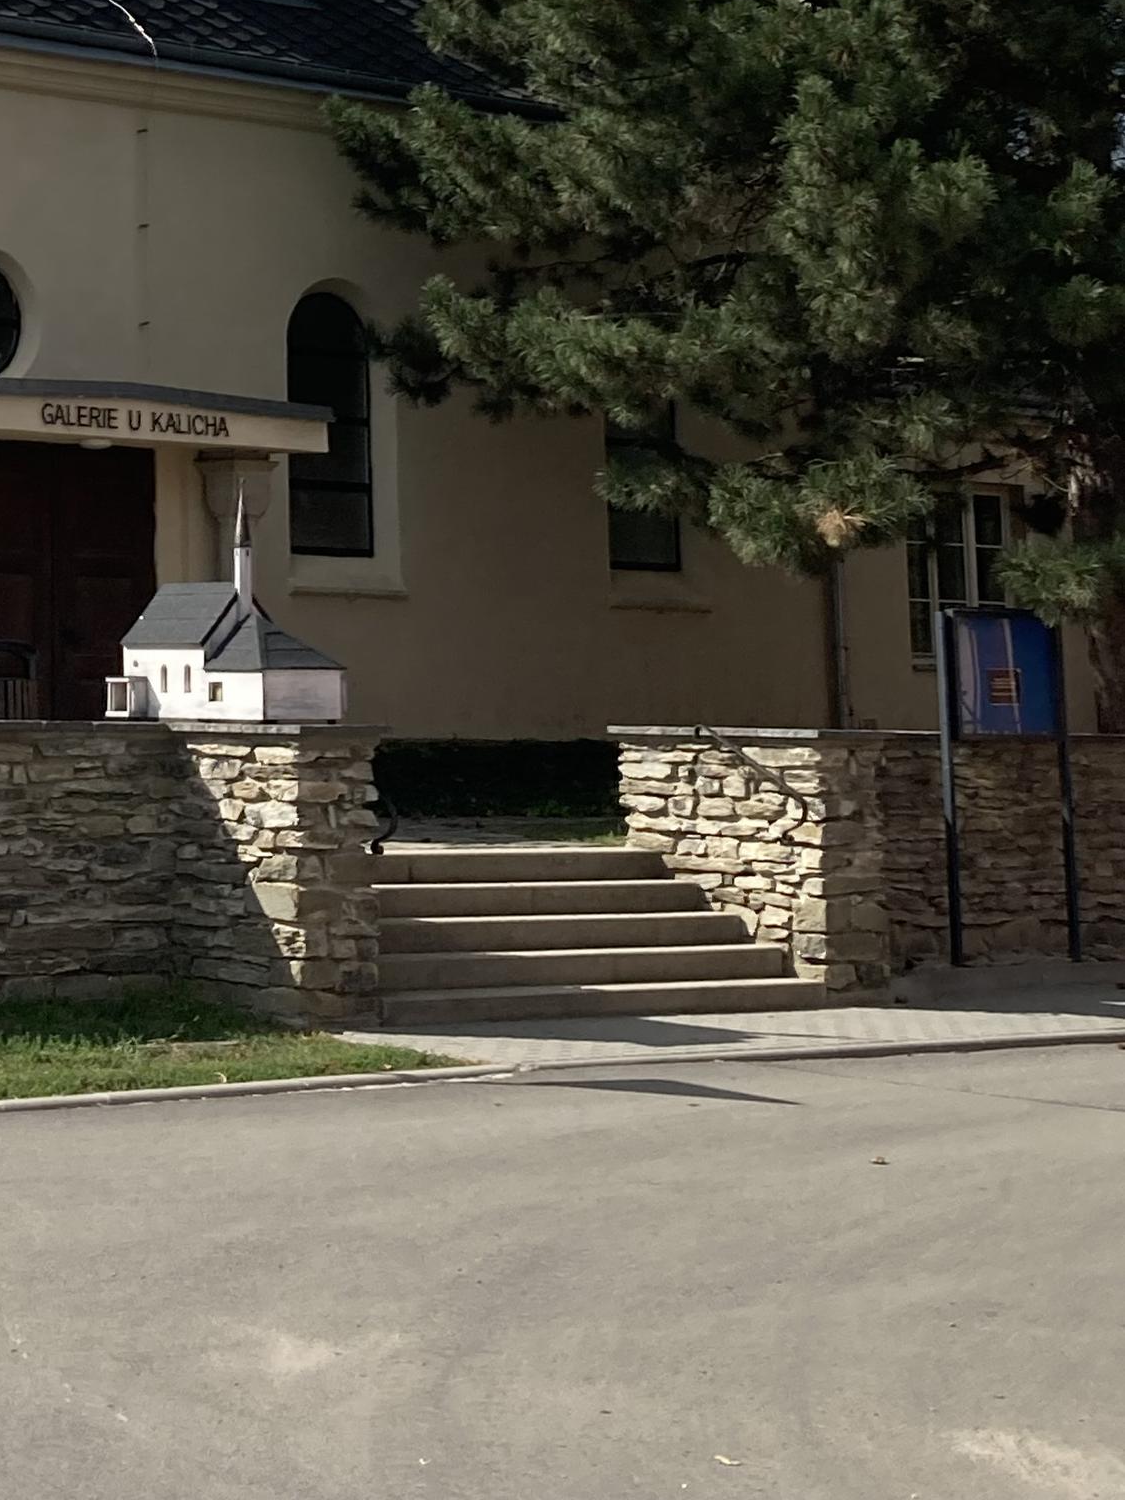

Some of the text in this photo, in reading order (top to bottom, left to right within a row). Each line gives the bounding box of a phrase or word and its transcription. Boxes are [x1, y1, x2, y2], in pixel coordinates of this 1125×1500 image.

[41, 402, 230, 438] GALERIE U KALICHA
